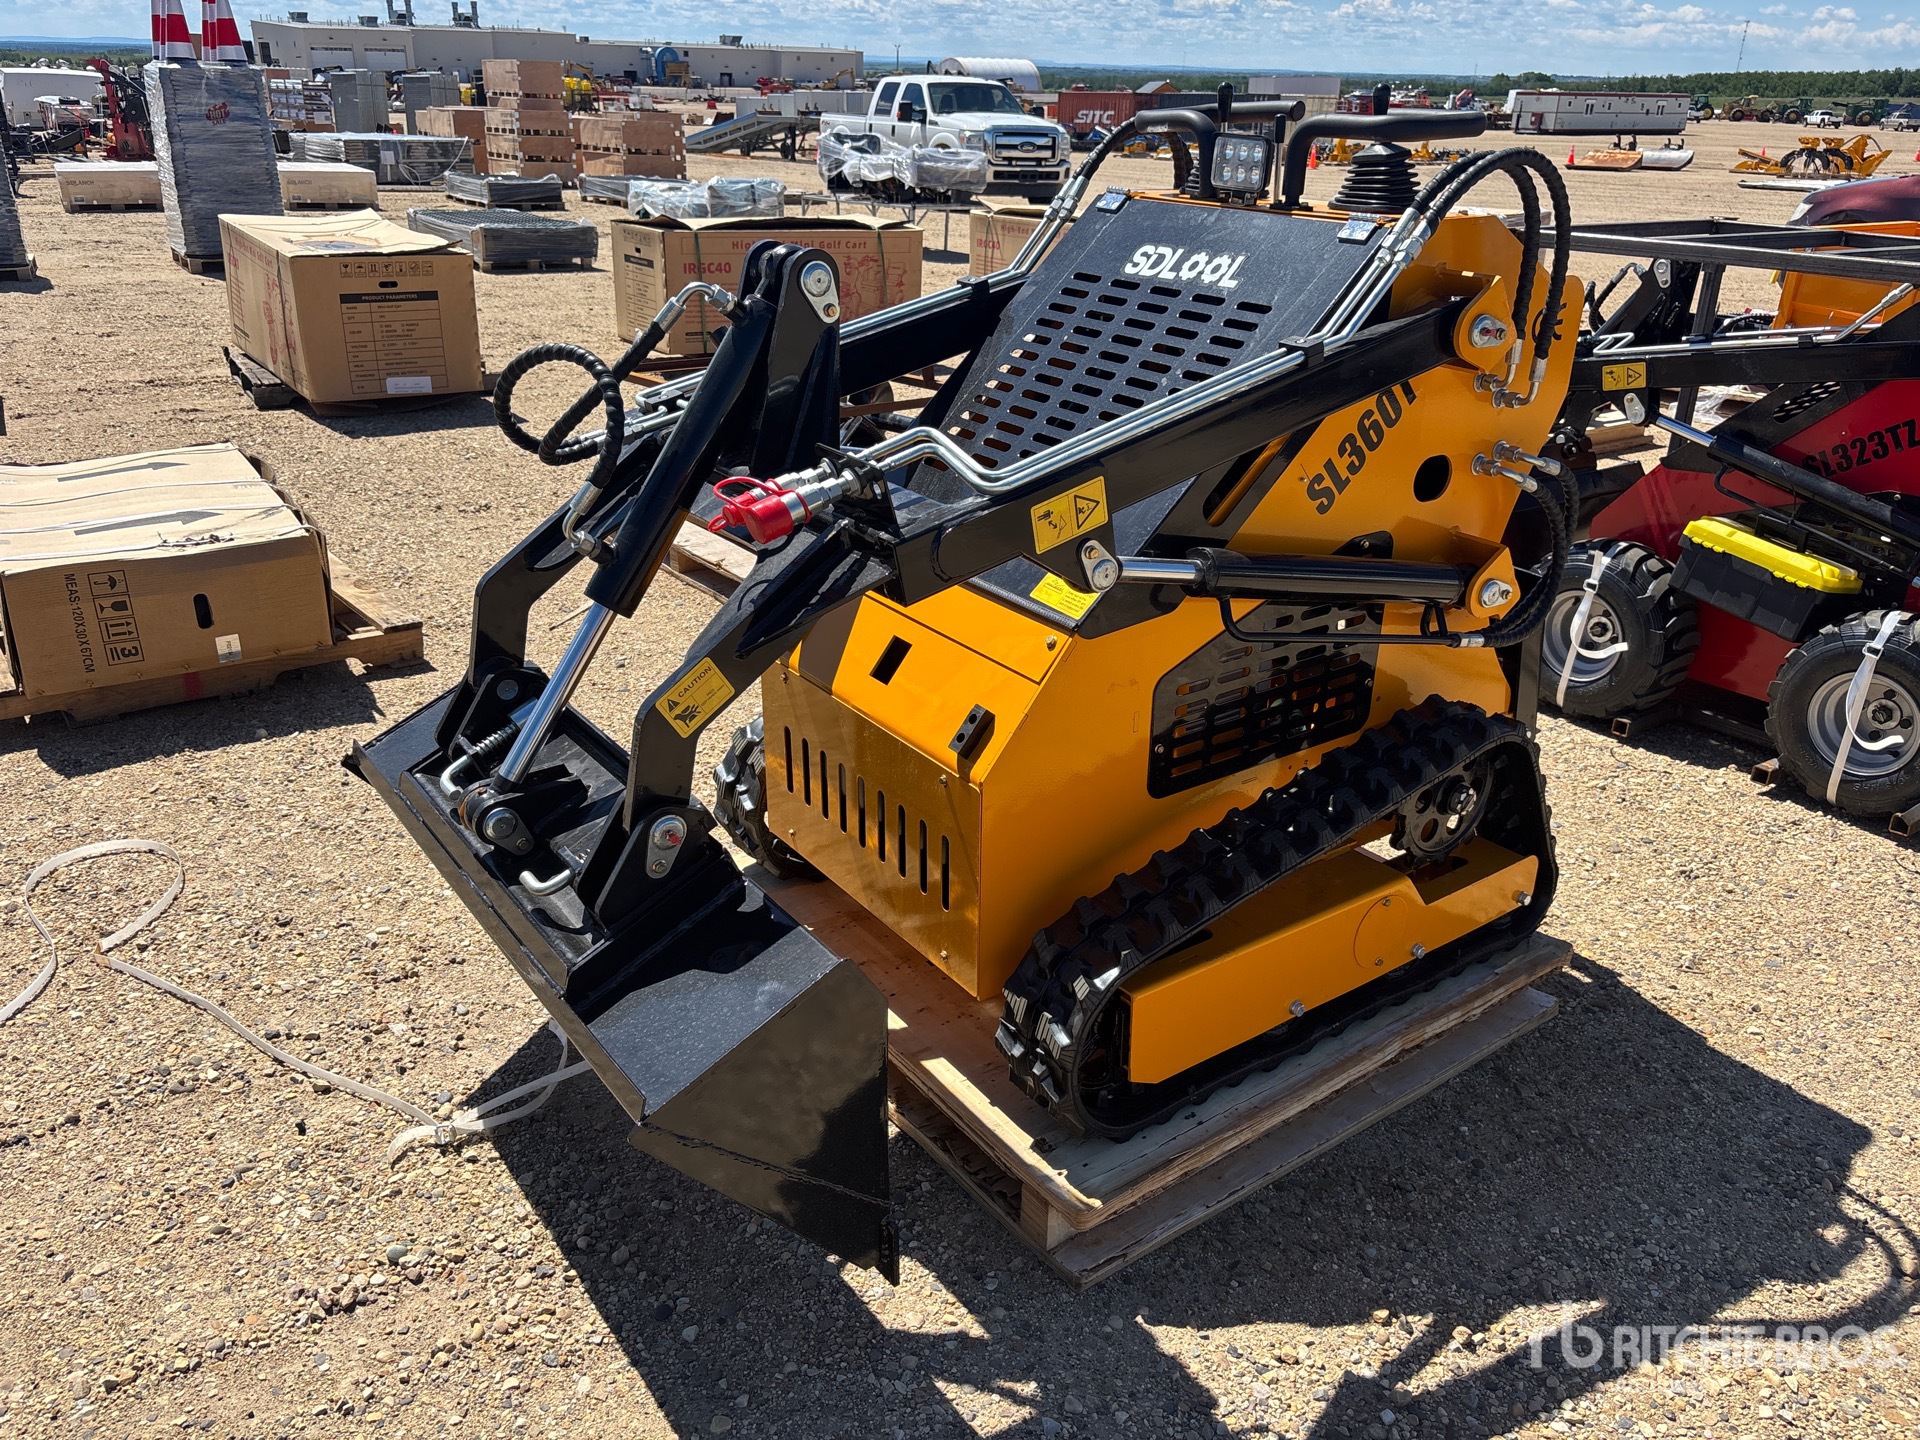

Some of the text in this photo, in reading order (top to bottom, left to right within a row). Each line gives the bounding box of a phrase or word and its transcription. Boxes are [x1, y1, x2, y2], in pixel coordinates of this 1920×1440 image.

[210, 109, 225, 120] HOT
[1073, 110, 1115, 124] SITC
[819, 240, 842, 249] Golf
[845, 240, 867, 249] Cart
[683, 262, 732, 275] IRGC40
[1124, 244, 1247, 288] SDLOOL
[1802, 418, 1920, 478] SL323TZ
[677, 666, 713, 698] CAUTION
